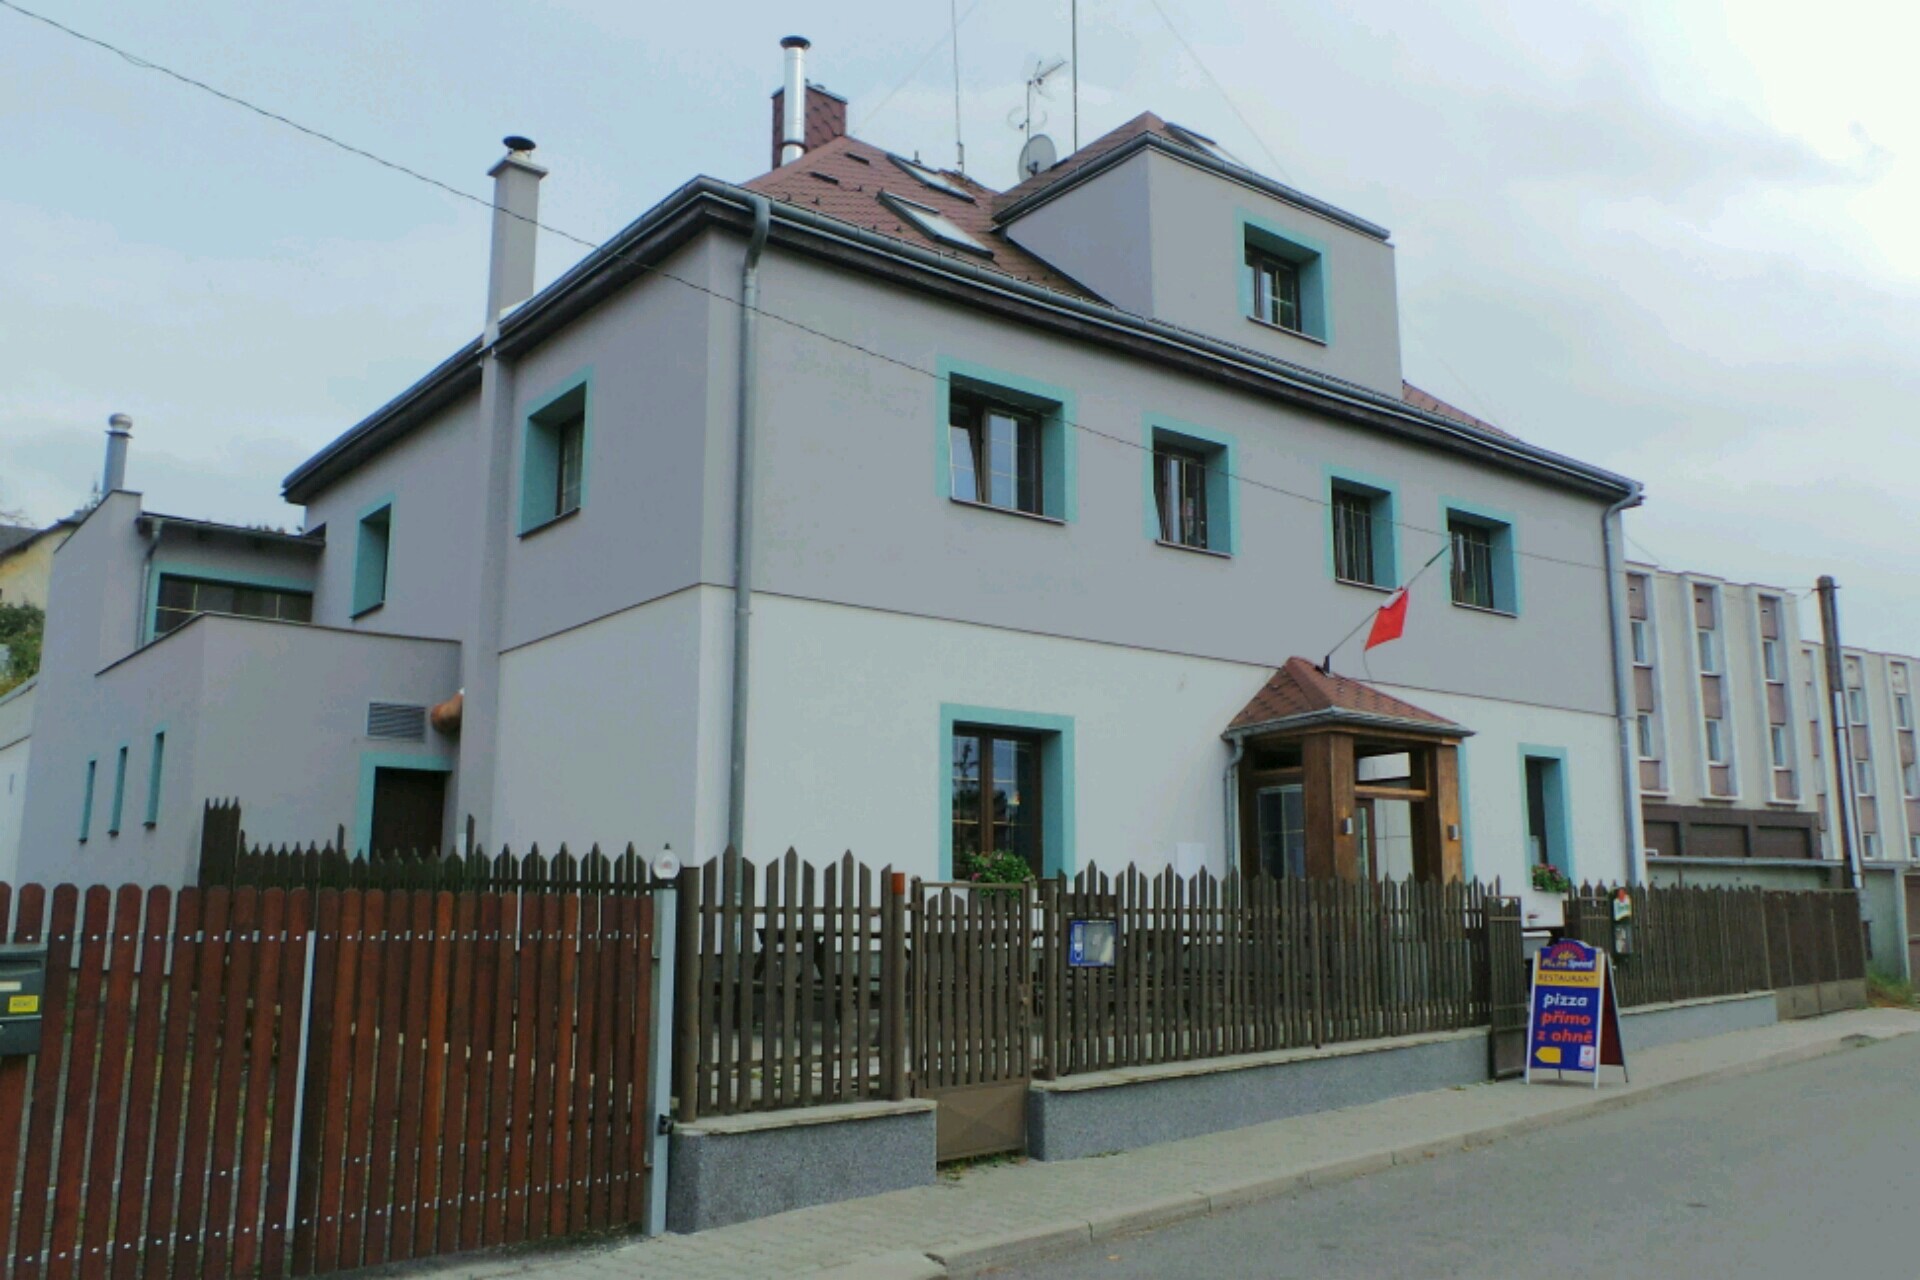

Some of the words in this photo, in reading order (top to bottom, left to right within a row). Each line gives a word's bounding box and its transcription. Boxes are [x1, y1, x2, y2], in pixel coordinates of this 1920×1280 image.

[1538, 974, 1596, 983] RESTAURANT
[1543, 993, 1588, 1008] pizza
[1541, 1010, 1590, 1026] přímo
[1537, 1030, 1546, 1041] z
[1552, 1028, 1593, 1043] ohně
